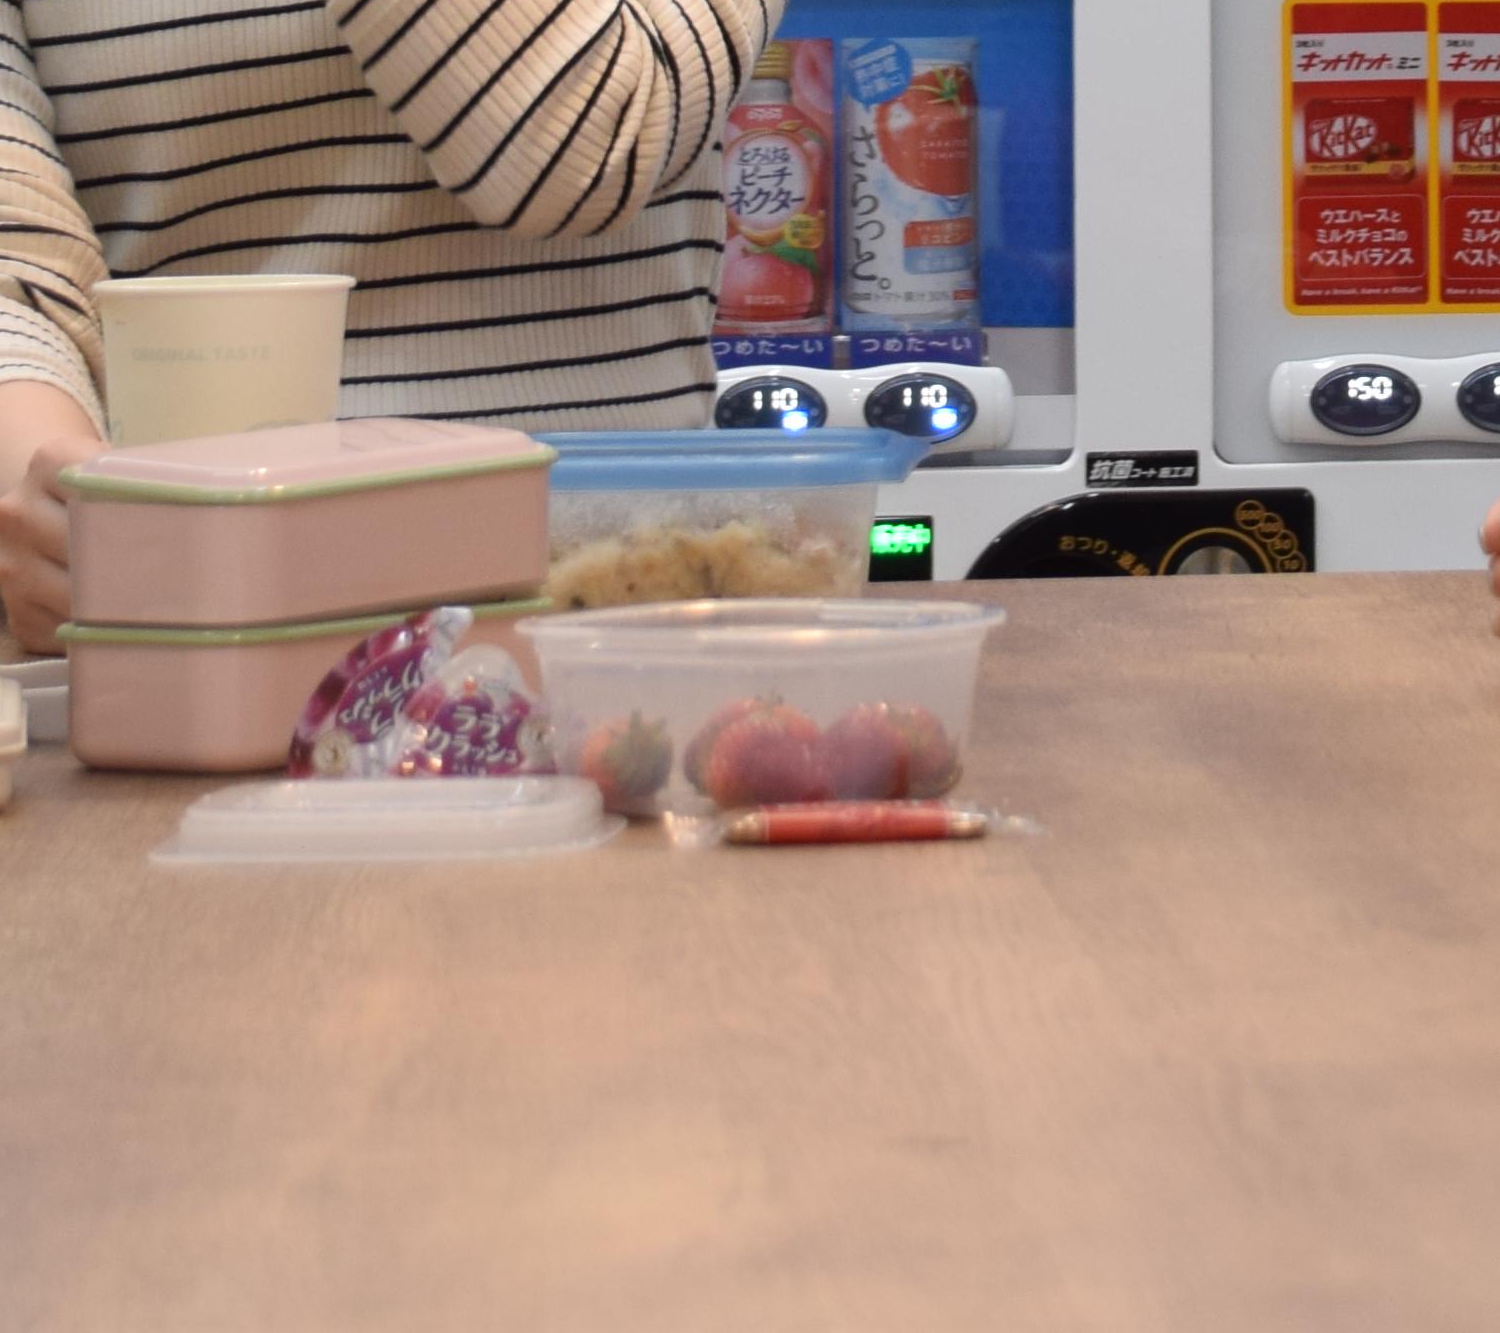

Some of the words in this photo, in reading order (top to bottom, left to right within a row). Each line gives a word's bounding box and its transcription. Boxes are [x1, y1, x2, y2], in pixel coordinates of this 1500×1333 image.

[1396, 57, 1421, 70] ミニ
[740, 165, 793, 186] ピーチ
[728, 186, 806, 215] ネクター
[1320, 208, 1402, 225] ウエハースと
[1316, 228, 1408, 244] ミルクチョコの
[1308, 247, 1415, 267] ベストバランス
[131, 348, 206, 363] ORIGINAL
[213, 345, 271, 361] TASTE
[902, 384, 948, 408] 110
[1347, 376, 1393, 400] 150
[752, 387, 799, 411] 110
